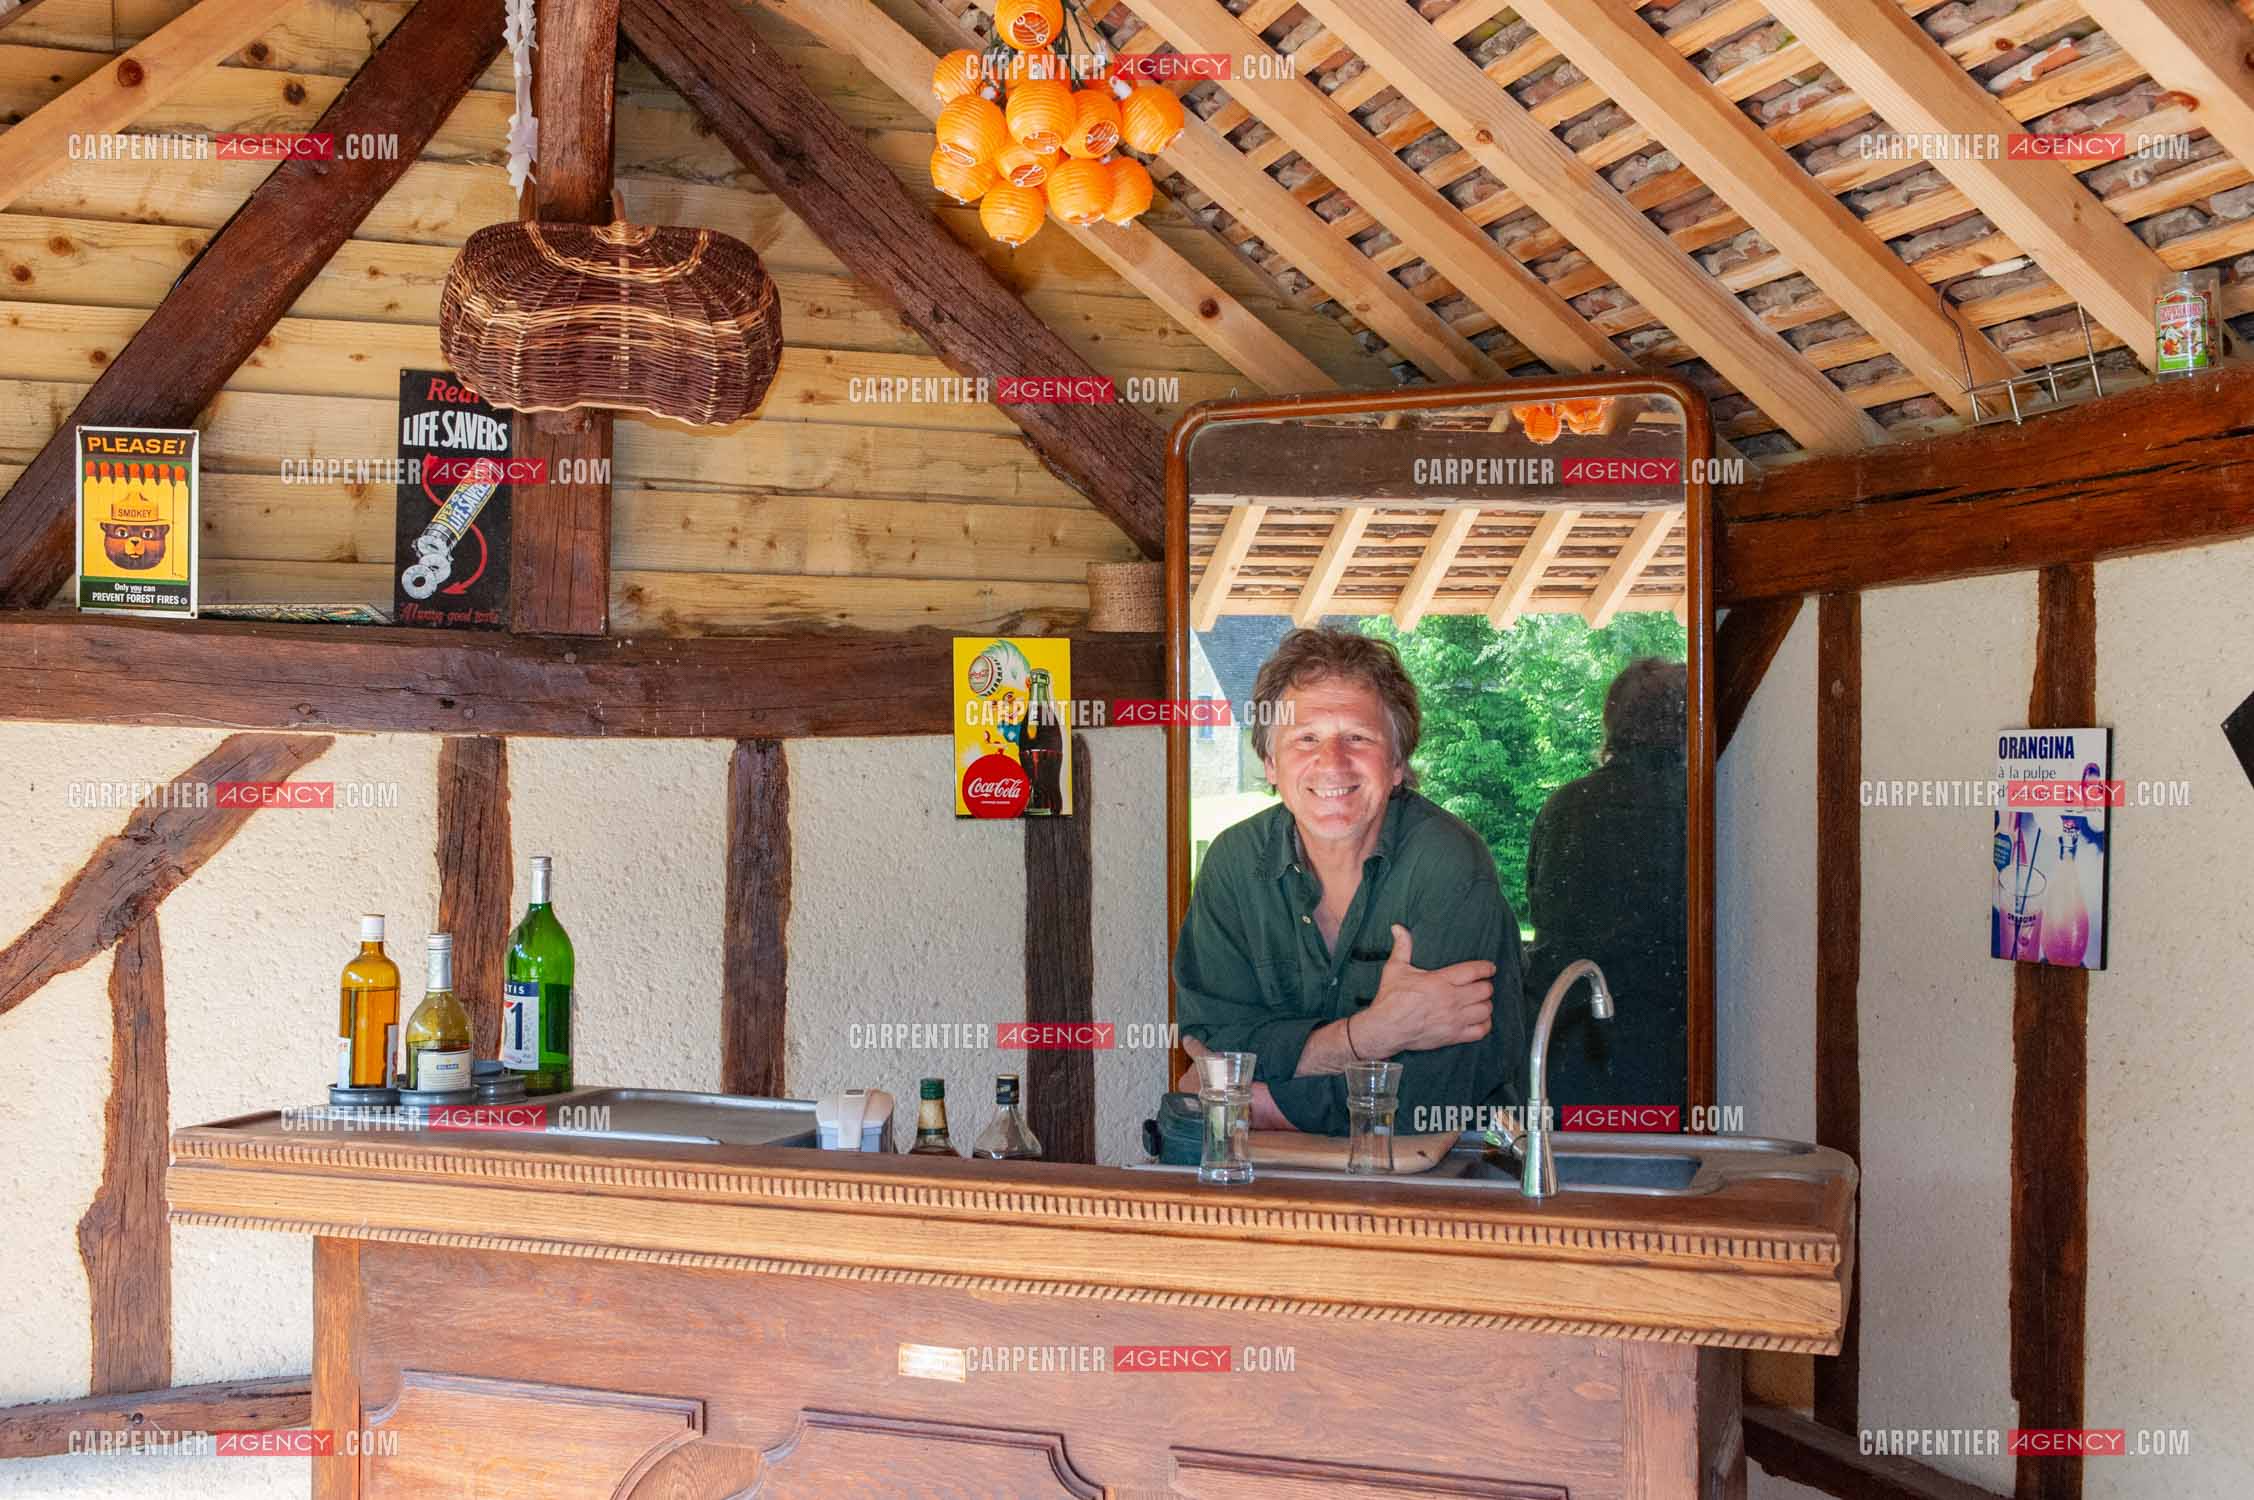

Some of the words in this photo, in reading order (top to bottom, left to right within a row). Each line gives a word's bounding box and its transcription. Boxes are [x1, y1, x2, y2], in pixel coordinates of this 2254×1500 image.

[402, 411, 439, 447] LIFE
[441, 410, 508, 452] SAVERS
[87, 436, 187, 455] PLEASE!
[118, 507, 152, 519] SMOKEY
[445, 506, 469, 530] LIFE
[92, 591, 125, 604] PREVENT
[126, 593, 156, 604] FOREST
[157, 595, 179, 605] FIRES
[114, 583, 129, 593] Only
[130, 585, 142, 594] you
[1998, 735, 2075, 760] ORANGINA
[1998, 765, 2005, 778] à
[2009, 765, 2019, 778] la
[2023, 765, 2057, 782] pulpe
[967, 777, 1023, 798] Coca-Cola
